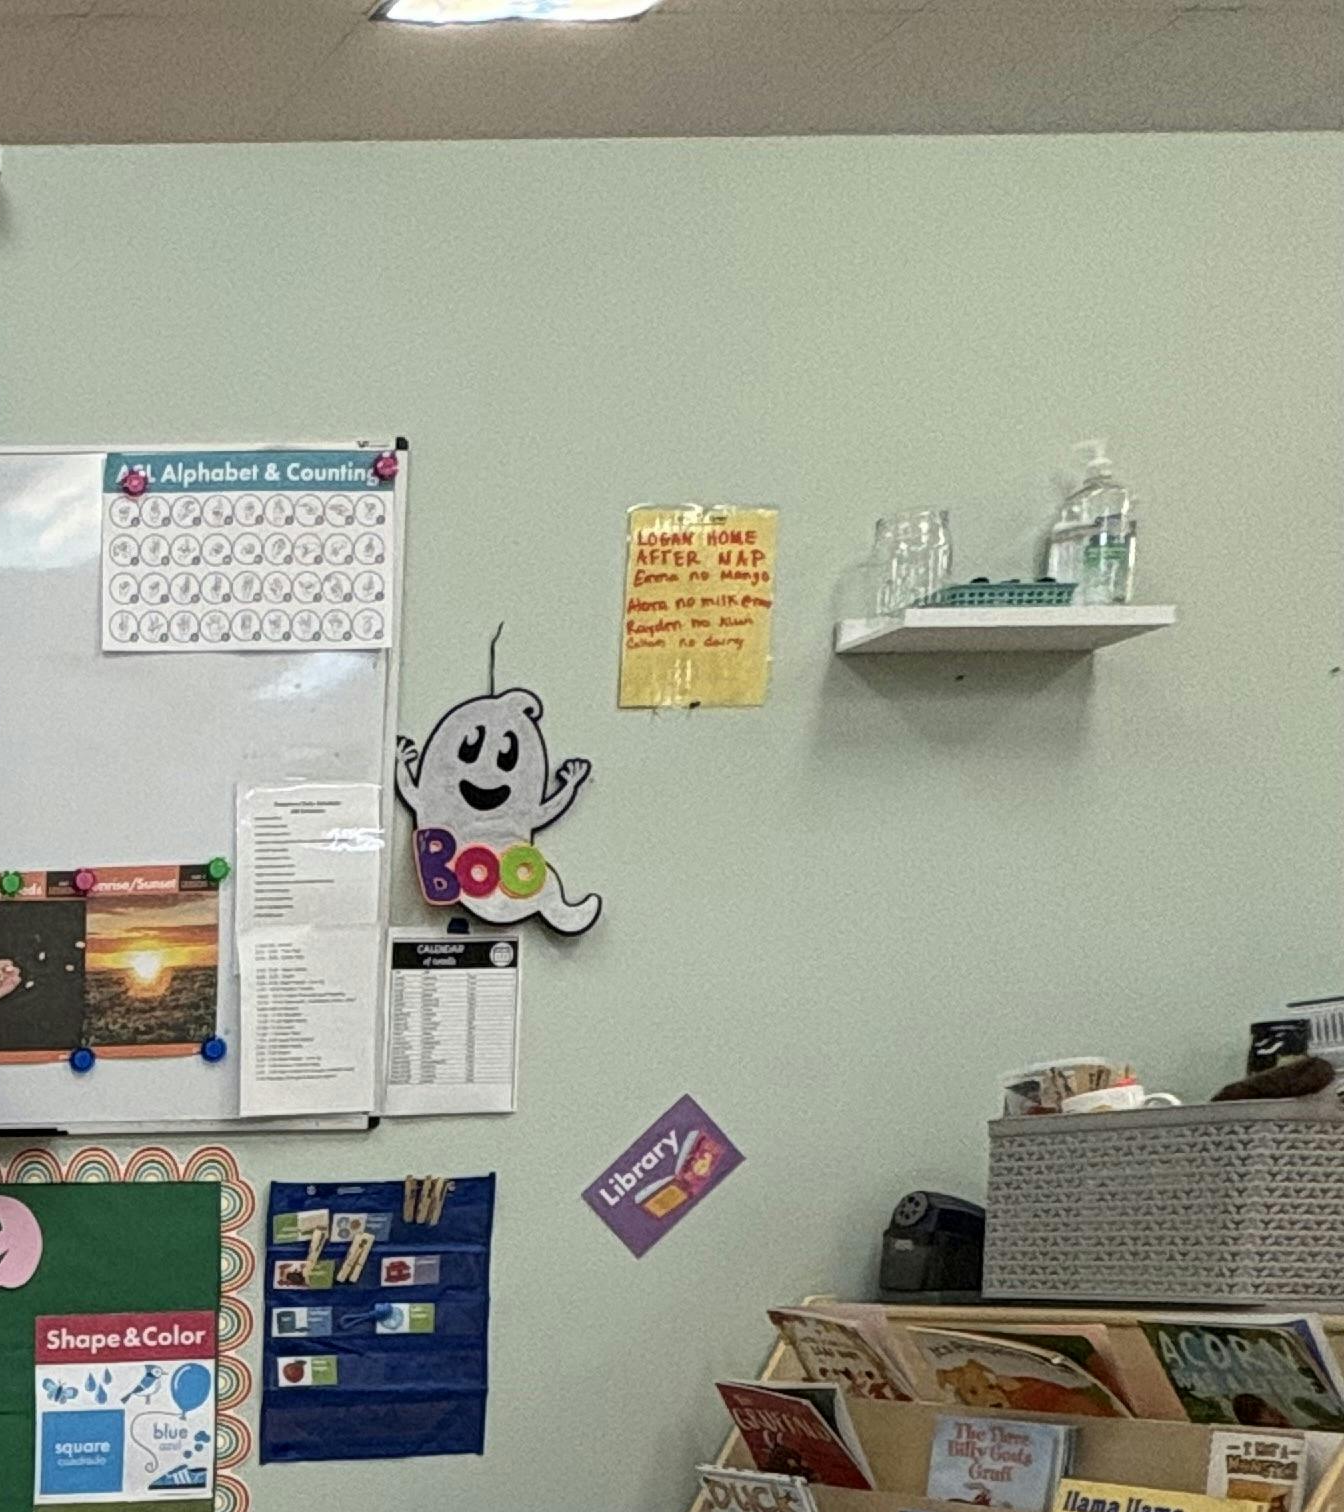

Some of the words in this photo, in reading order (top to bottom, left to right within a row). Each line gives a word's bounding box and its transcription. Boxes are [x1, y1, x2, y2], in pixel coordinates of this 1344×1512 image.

[117, 463, 155, 483] AL
[160, 461, 259, 487] Alphabet
[264, 463, 283, 482] &
[637, 530, 695, 546] LOGAN
[706, 530, 758, 546] HOME
[637, 550, 702, 567] AFTER
[718, 550, 766, 567] NAP
[689, 570, 710, 581] no
[675, 596, 697, 611] no
[691, 617, 711, 628] no
[415, 826, 548, 905] BOO
[599, 1128, 680, 1207] Library
[47, 1330, 122, 1354] Shape
[123, 1330, 141, 1348] &
[142, 1326, 206, 1347] Color
[152, 1423, 188, 1441] blue
[54, 1439, 111, 1458] square
